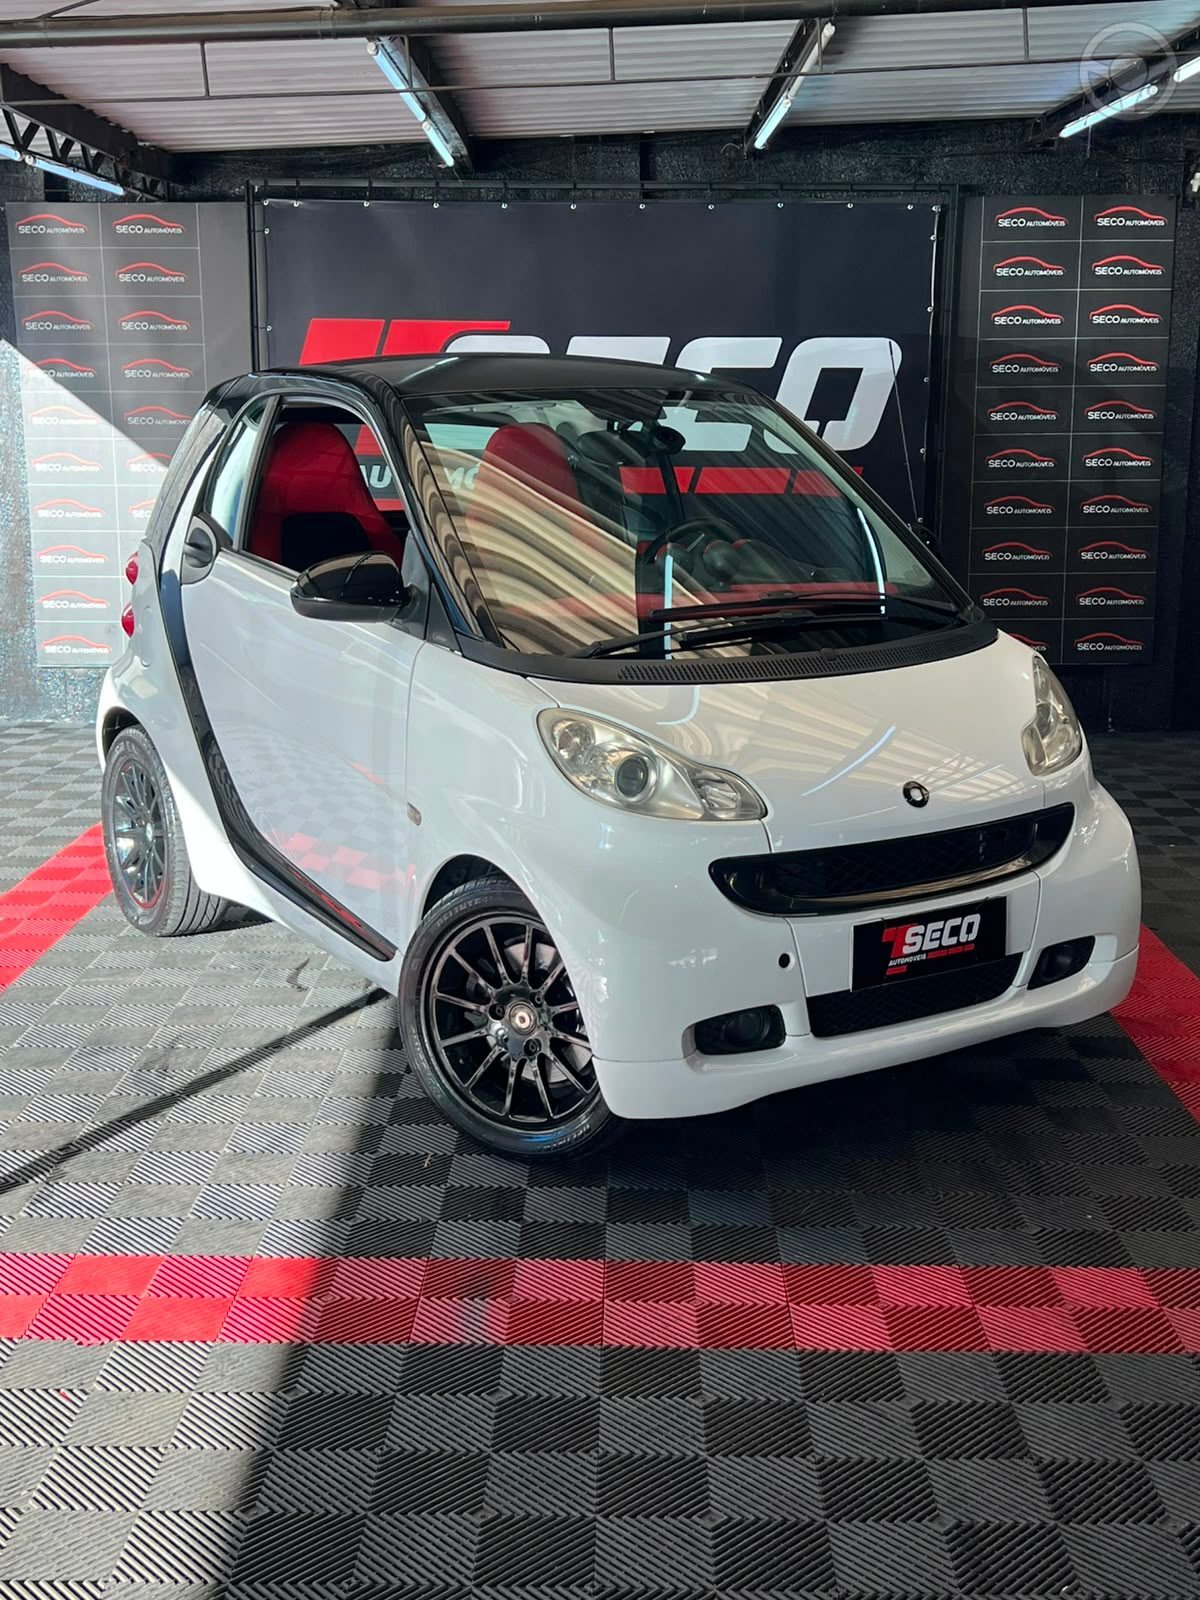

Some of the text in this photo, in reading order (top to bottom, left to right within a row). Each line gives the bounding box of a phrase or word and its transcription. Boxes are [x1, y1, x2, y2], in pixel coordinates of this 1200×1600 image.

[998, 219, 1025, 227] SECO
[1097, 218, 1124, 226] SECO
[18, 225, 45, 233] SECO
[116, 225, 143, 233] SECO
[996, 268, 1023, 276] SECO
[1095, 267, 1122, 275] SECO
[22, 274, 49, 282] SECO
[119, 274, 145, 282] SECO
[1092, 316, 1120, 324] SECO
[25, 322, 52, 330] SECO
[121, 322, 148, 330] SECO
[992, 365, 1019, 373] SECO
[1090, 364, 1117, 372] SECO
[125, 370, 151, 378] SECO
[128, 417, 154, 425] SECO
[988, 460, 1015, 468] SECO
[1085, 459, 1112, 467] SECO
[1081, 552, 1108, 560] SECO
